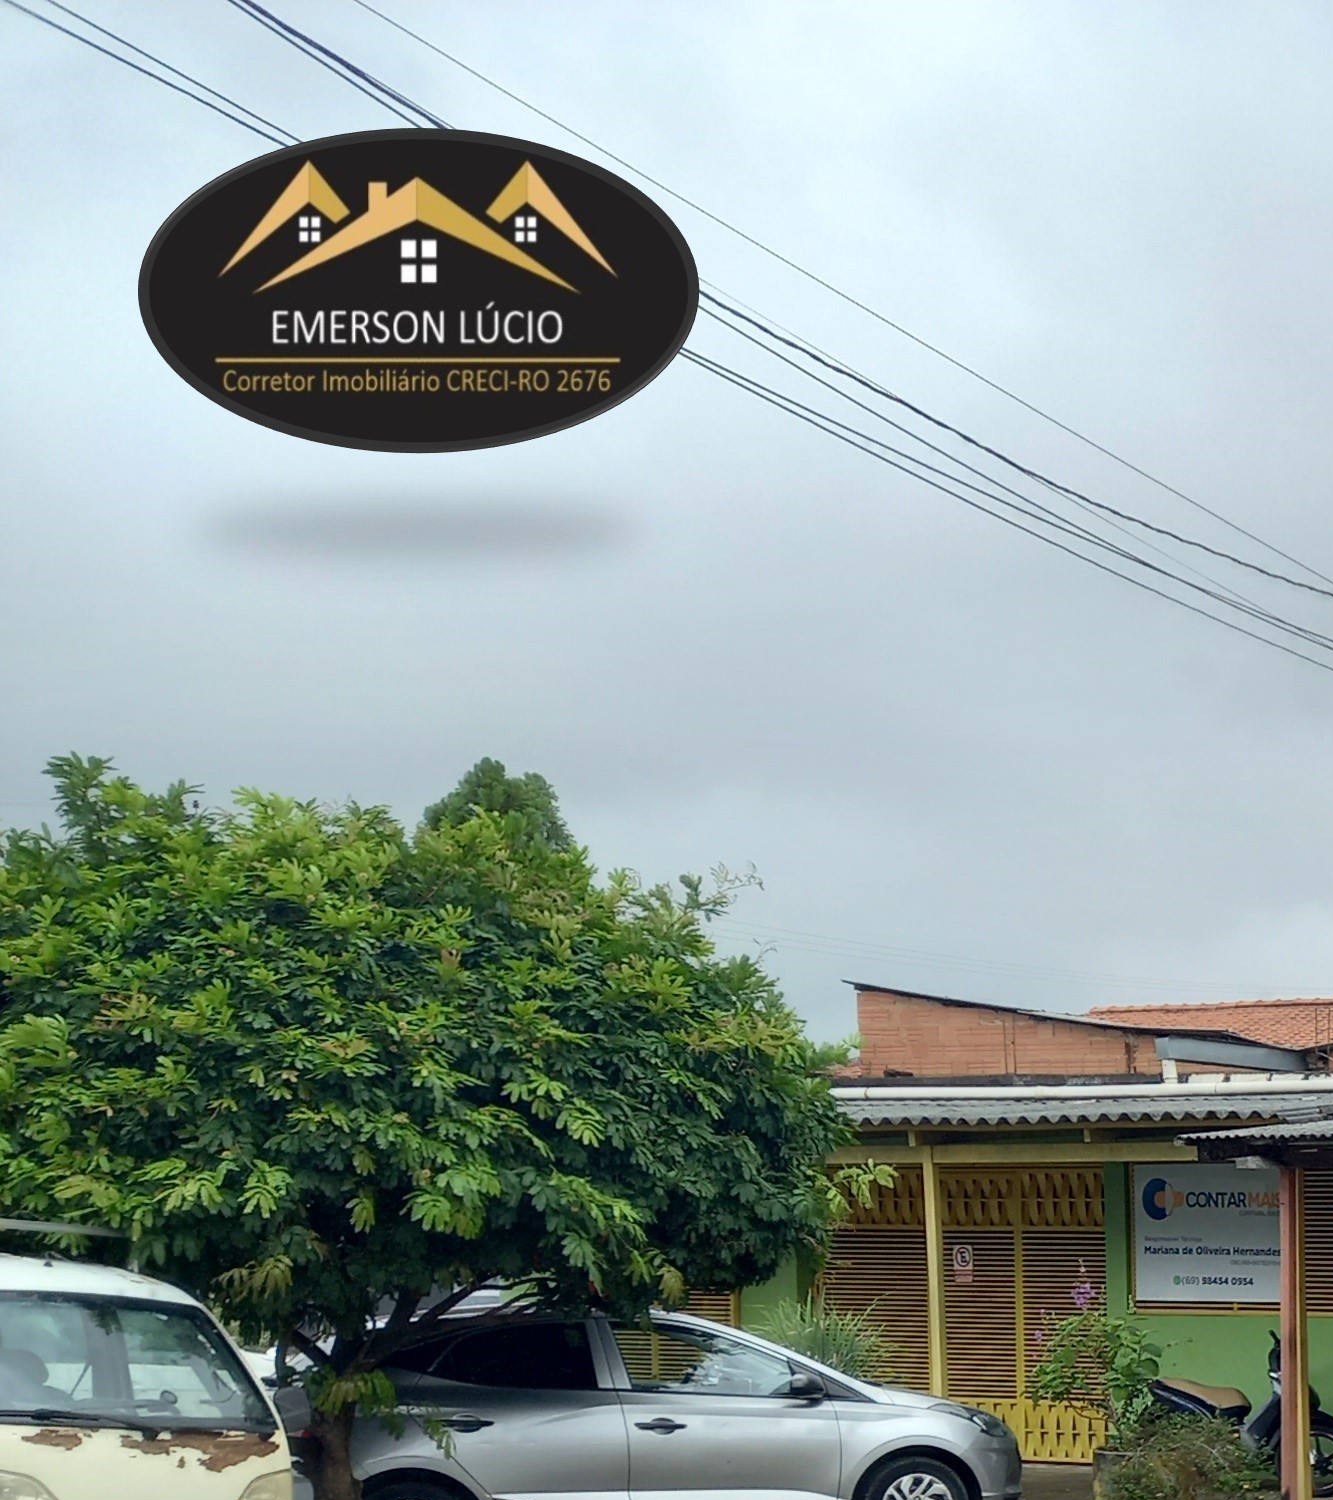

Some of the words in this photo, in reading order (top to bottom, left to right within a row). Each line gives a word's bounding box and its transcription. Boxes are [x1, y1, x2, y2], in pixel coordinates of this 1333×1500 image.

[1143, 1245, 1180, 1256] Mariana
[1181, 1245, 1194, 1256] de
[1195, 1245, 1231, 1257] Oliveira
